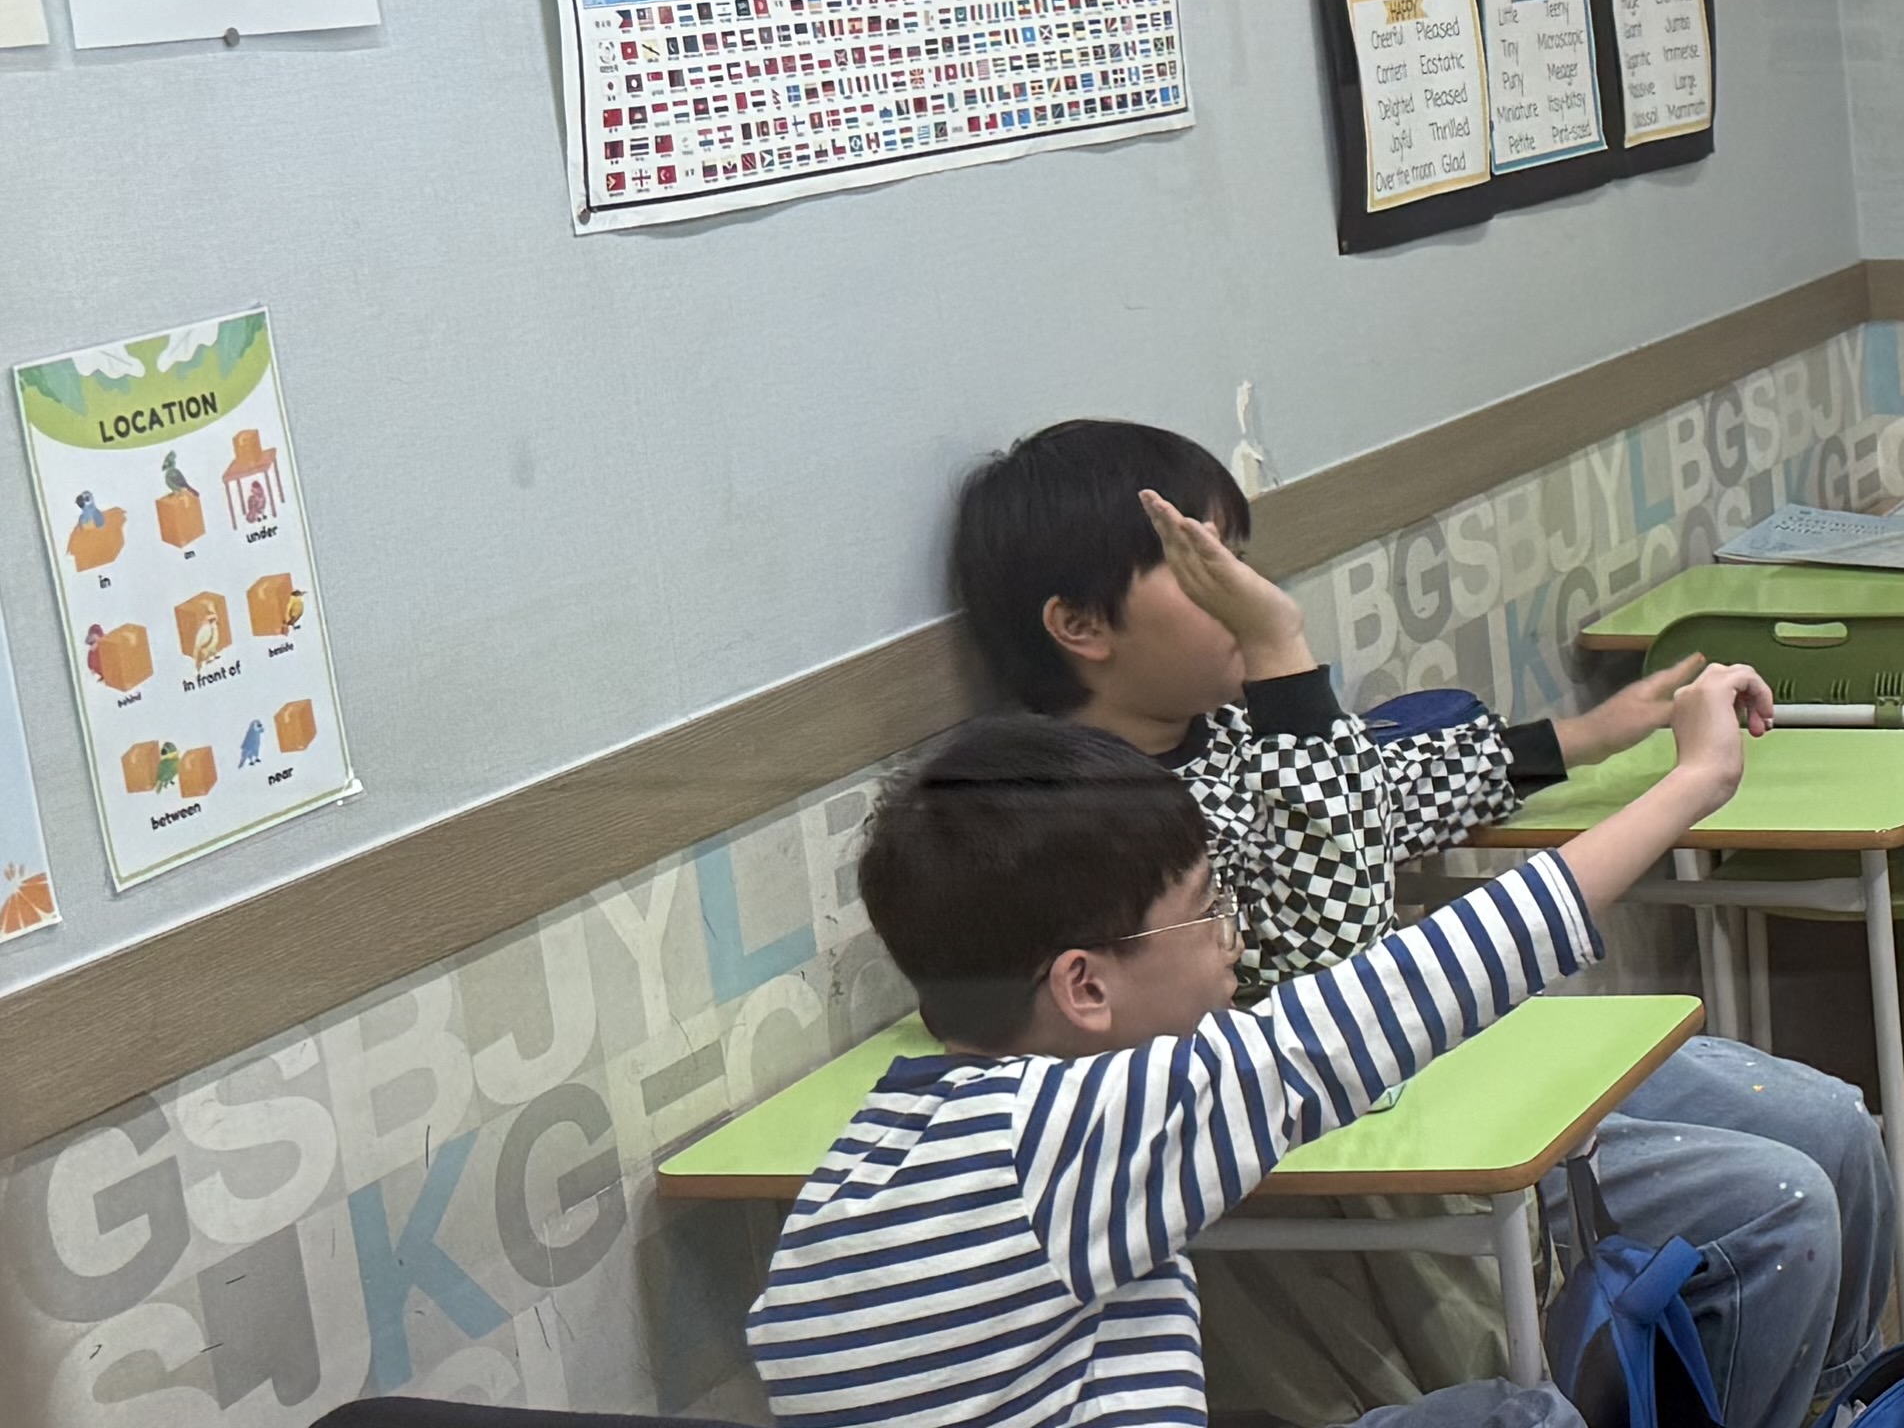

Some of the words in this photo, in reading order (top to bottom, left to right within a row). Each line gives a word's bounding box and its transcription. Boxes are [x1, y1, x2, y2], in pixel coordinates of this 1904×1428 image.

[1416, 17, 1460, 40] Pleased
[1420, 52, 1464, 75] Ecstatic
[1424, 83, 1468, 108] Pleased
[1430, 122, 1470, 142] Thrilled
[1442, 150, 1466, 173] Glad
[99, 392, 218, 443] LOCATION
[246, 526, 278, 543] under
[198, 668, 226, 688] front
[228, 661, 241, 676] of
[268, 767, 294, 786] near
[151, 802, 202, 830] between
